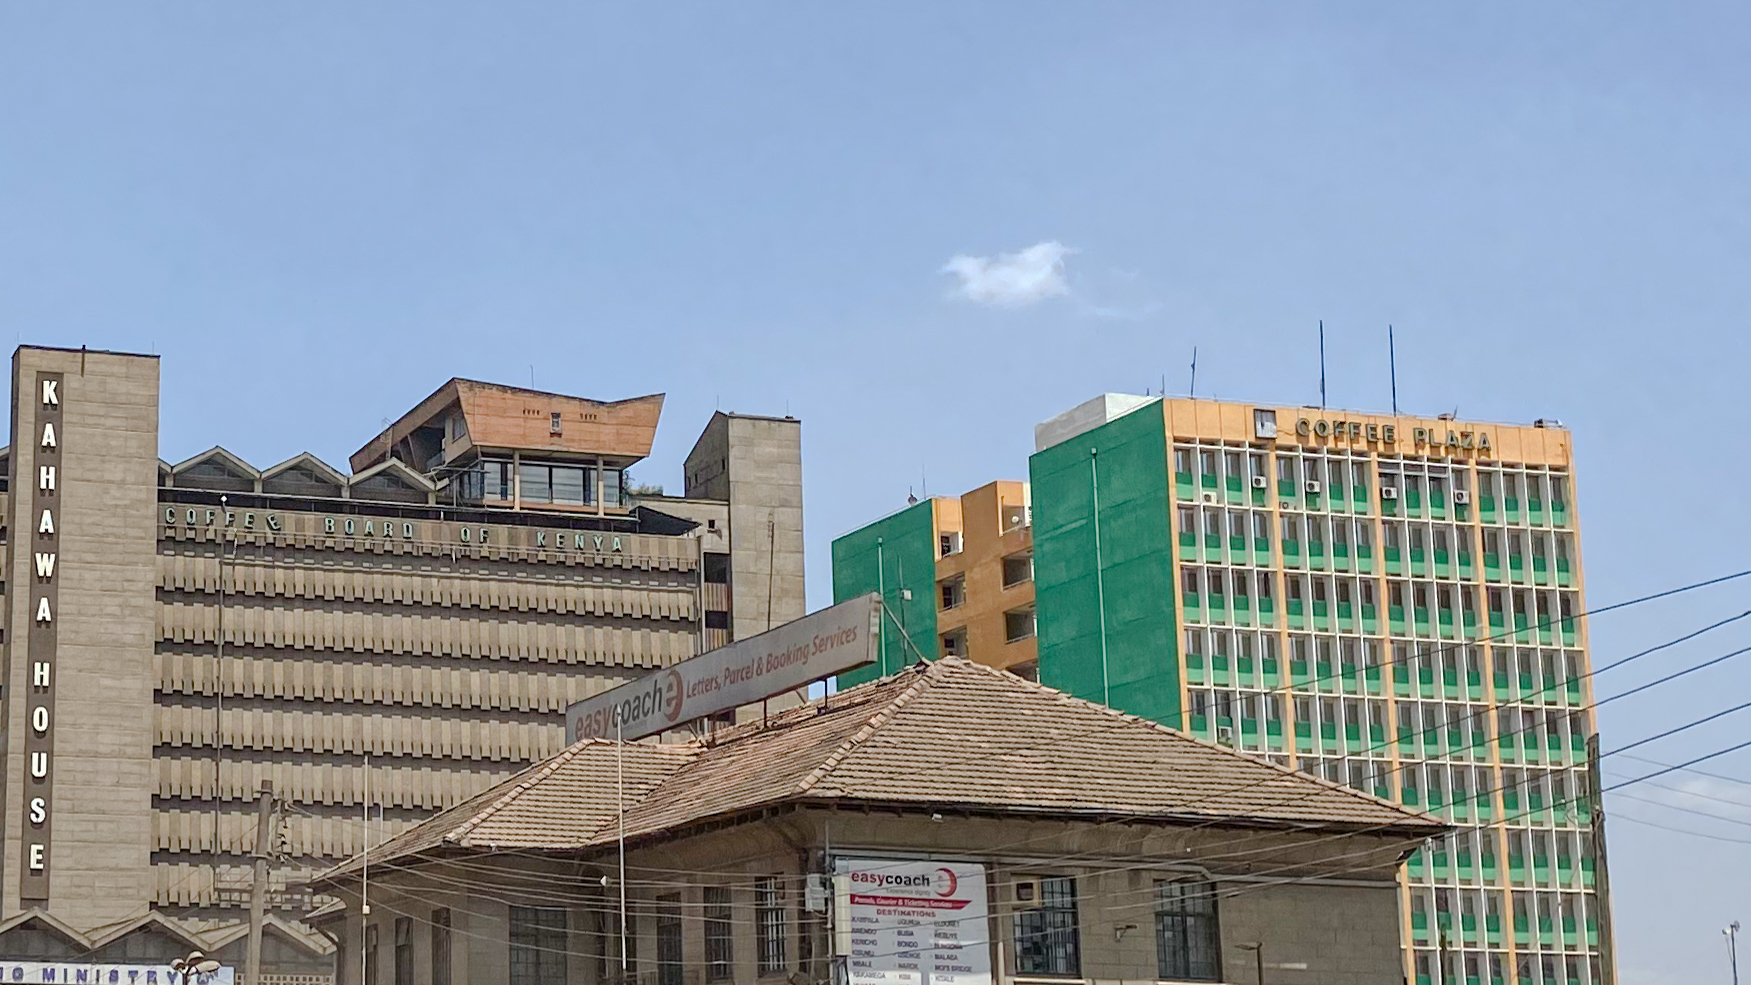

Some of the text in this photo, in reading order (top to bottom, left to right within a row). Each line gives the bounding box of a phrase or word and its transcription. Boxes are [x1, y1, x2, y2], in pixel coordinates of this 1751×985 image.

[1296, 418, 1492, 450] COFFEE PLAZA
[165, 507, 623, 552] COFFEE BOARD OF KENYA
[29, 380, 59, 871] KAHAWA HOUSE
[686, 624, 858, 700] Letters, Parcel & Booking Services
[574, 679, 663, 740] easycoach
[851, 871, 930, 887] easycoach
[876, 908, 937, 918] DESTINATIONS
[41, 967, 179, 985] MINISTRY
